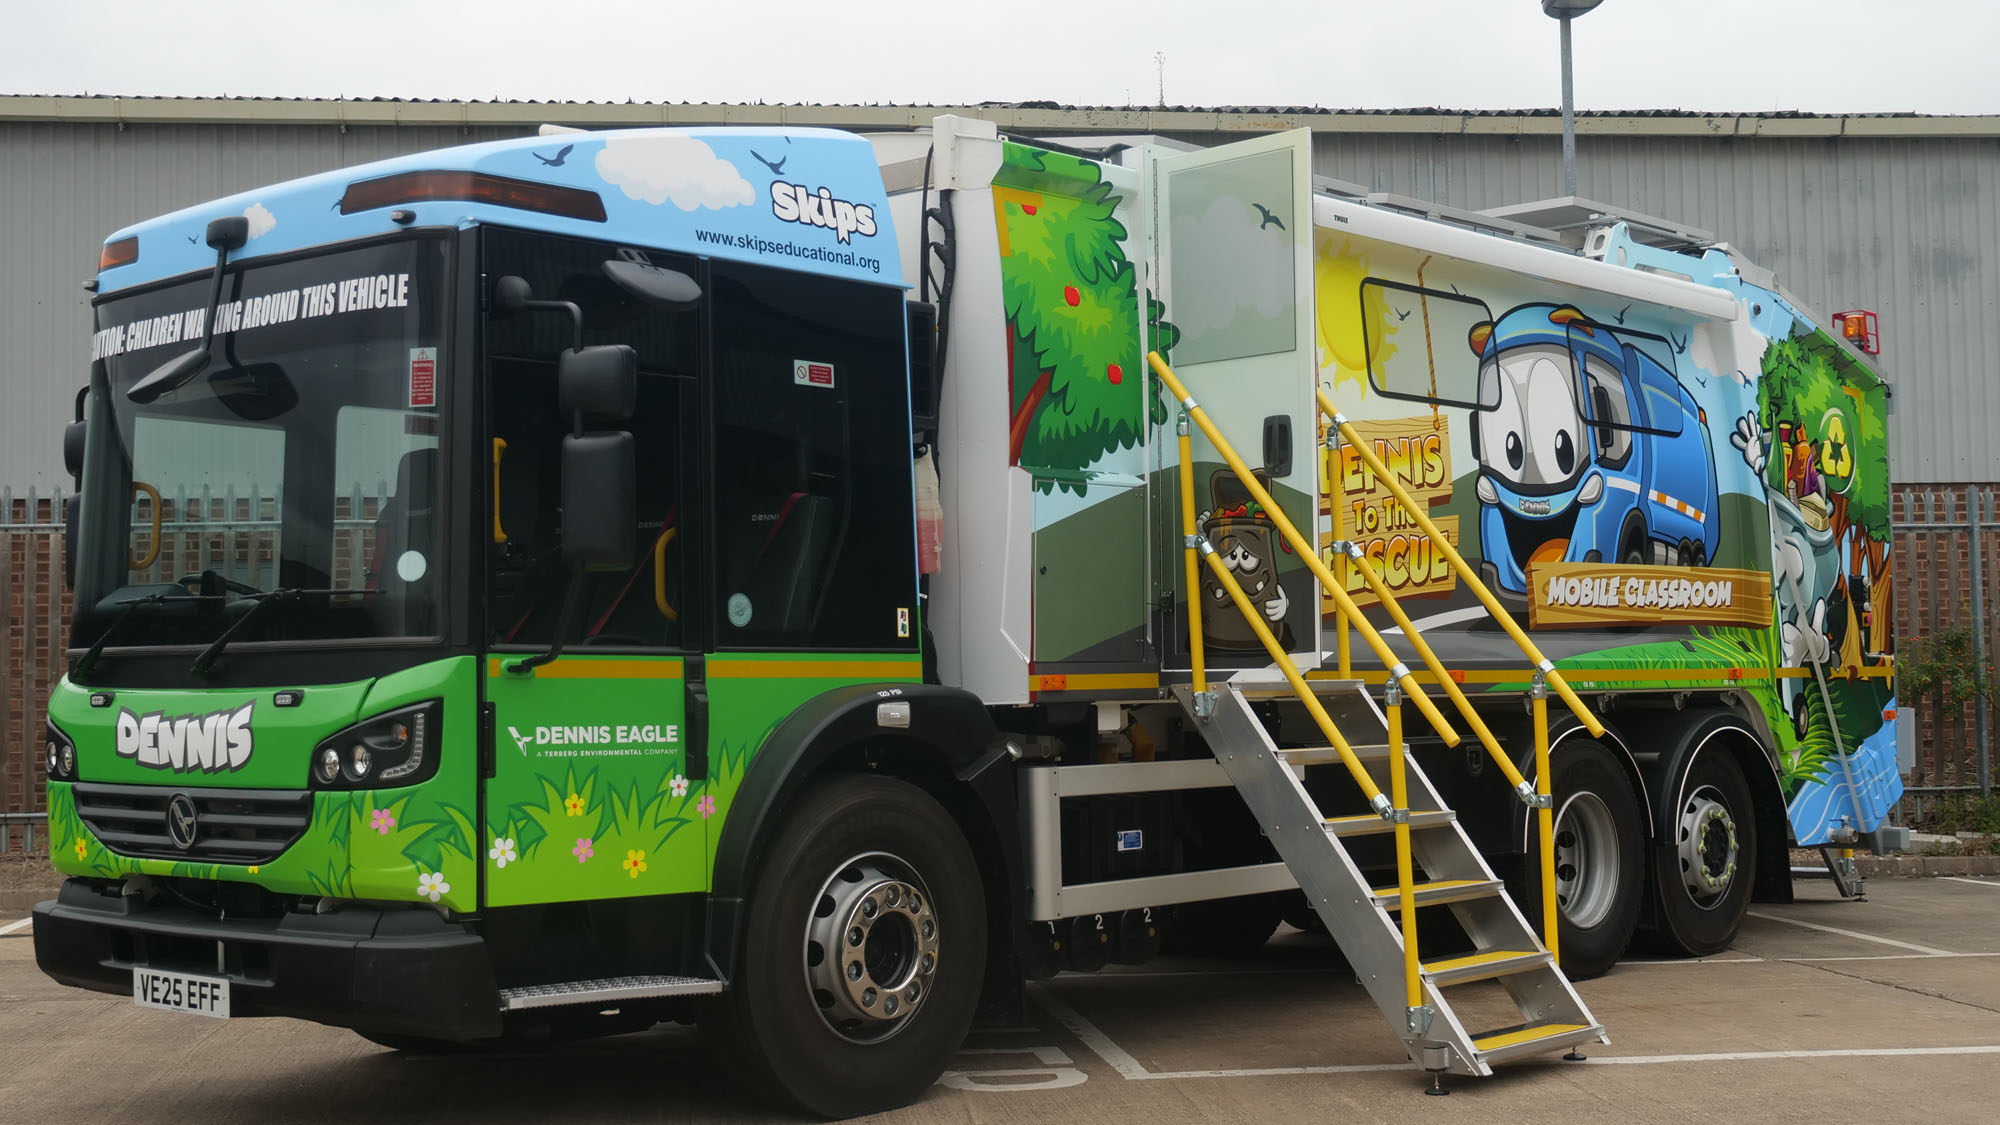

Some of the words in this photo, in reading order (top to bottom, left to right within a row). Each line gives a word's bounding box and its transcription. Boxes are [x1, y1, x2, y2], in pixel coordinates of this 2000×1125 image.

[770, 180, 877, 245] Skips
[695, 229, 880, 273] www.skipseducational.org
[126, 313, 184, 352] CHILDREN
[183, 300, 242, 340] WAING
[241, 289, 300, 330] AROUND
[302, 283, 335, 319] THIS
[338, 273, 409, 313] VEHICLE
[1547, 576, 1620, 607] MOBILE
[1625, 577, 1732, 609] CLASSROOM
[116, 700, 255, 773] DENNIS
[536, 726, 611, 744] DENNIS
[616, 725, 678, 743] EAGLE
[580, 749, 642, 757] ENVIRONMENTAL
[1095, 914, 1104, 929] 2
[1143, 907, 1152, 923] 2
[141, 974, 183, 1006] VE25
[187, 980, 221, 1011] EFF
